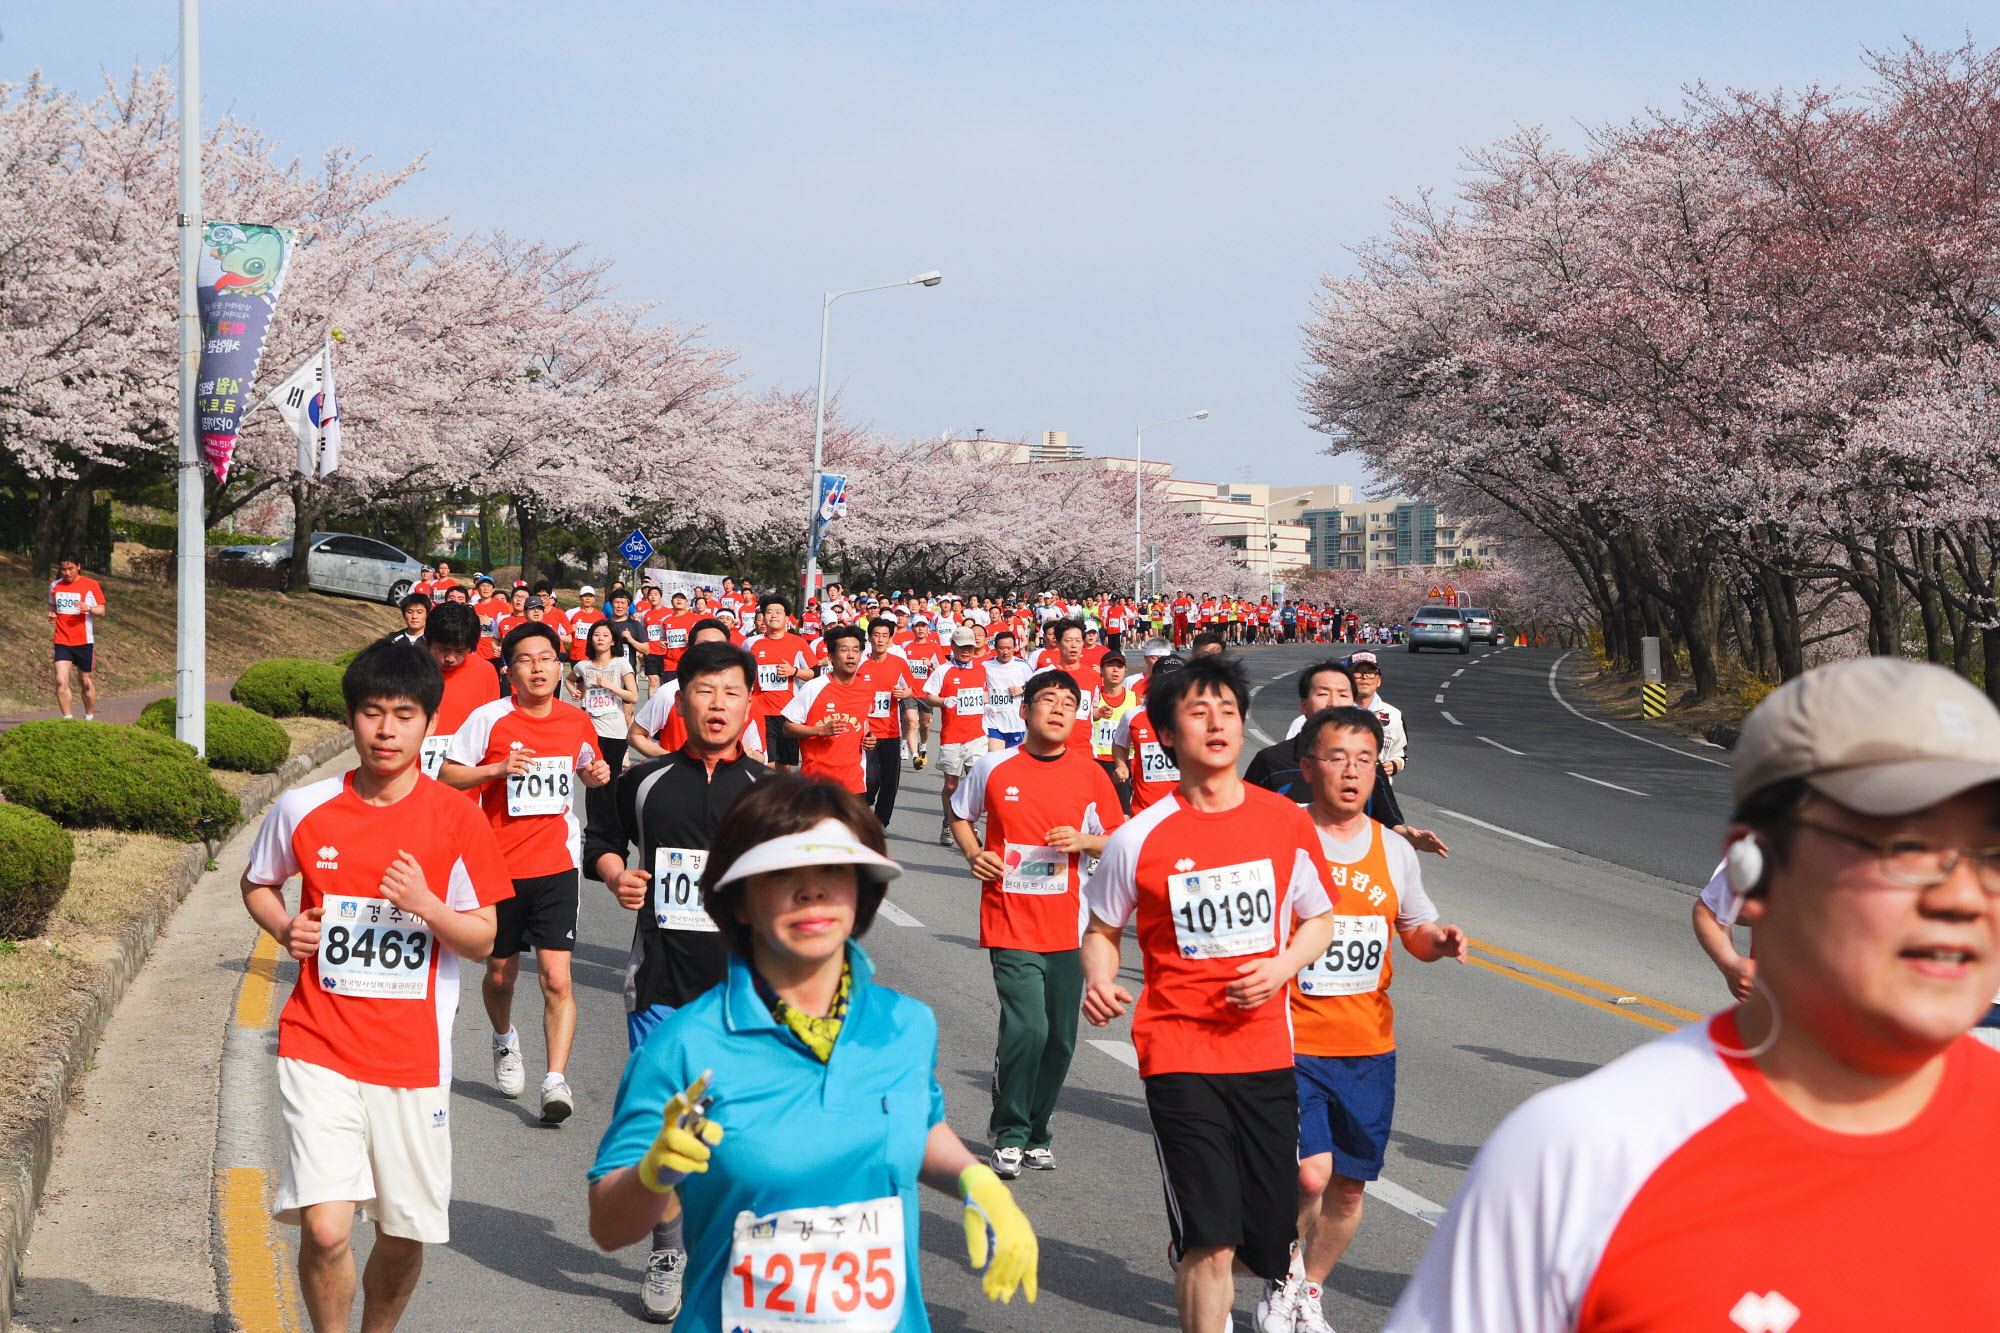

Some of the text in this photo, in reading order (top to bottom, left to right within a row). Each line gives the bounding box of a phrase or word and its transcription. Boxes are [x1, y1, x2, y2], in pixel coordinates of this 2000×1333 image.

[910, 664, 927, 675] 0539
[588, 695, 616, 709] 12901
[959, 696, 984, 707] 10213
[991, 695, 1014, 705] 10904
[512, 774, 570, 798] 7018
[316, 860, 339, 870] errea
[1005, 880, 1065, 891] 현대푸드시스템
[1208, 868, 1261, 891] 경주시
[1331, 866, 1387, 907] 선관위
[1180, 888, 1271, 933] 10190
[1334, 920, 1378, 936] 경주시
[325, 926, 427, 970] 8463
[1307, 939, 1382, 972] 598
[793, 1210, 880, 1241] 경주시
[733, 1247, 895, 1314] 12735
